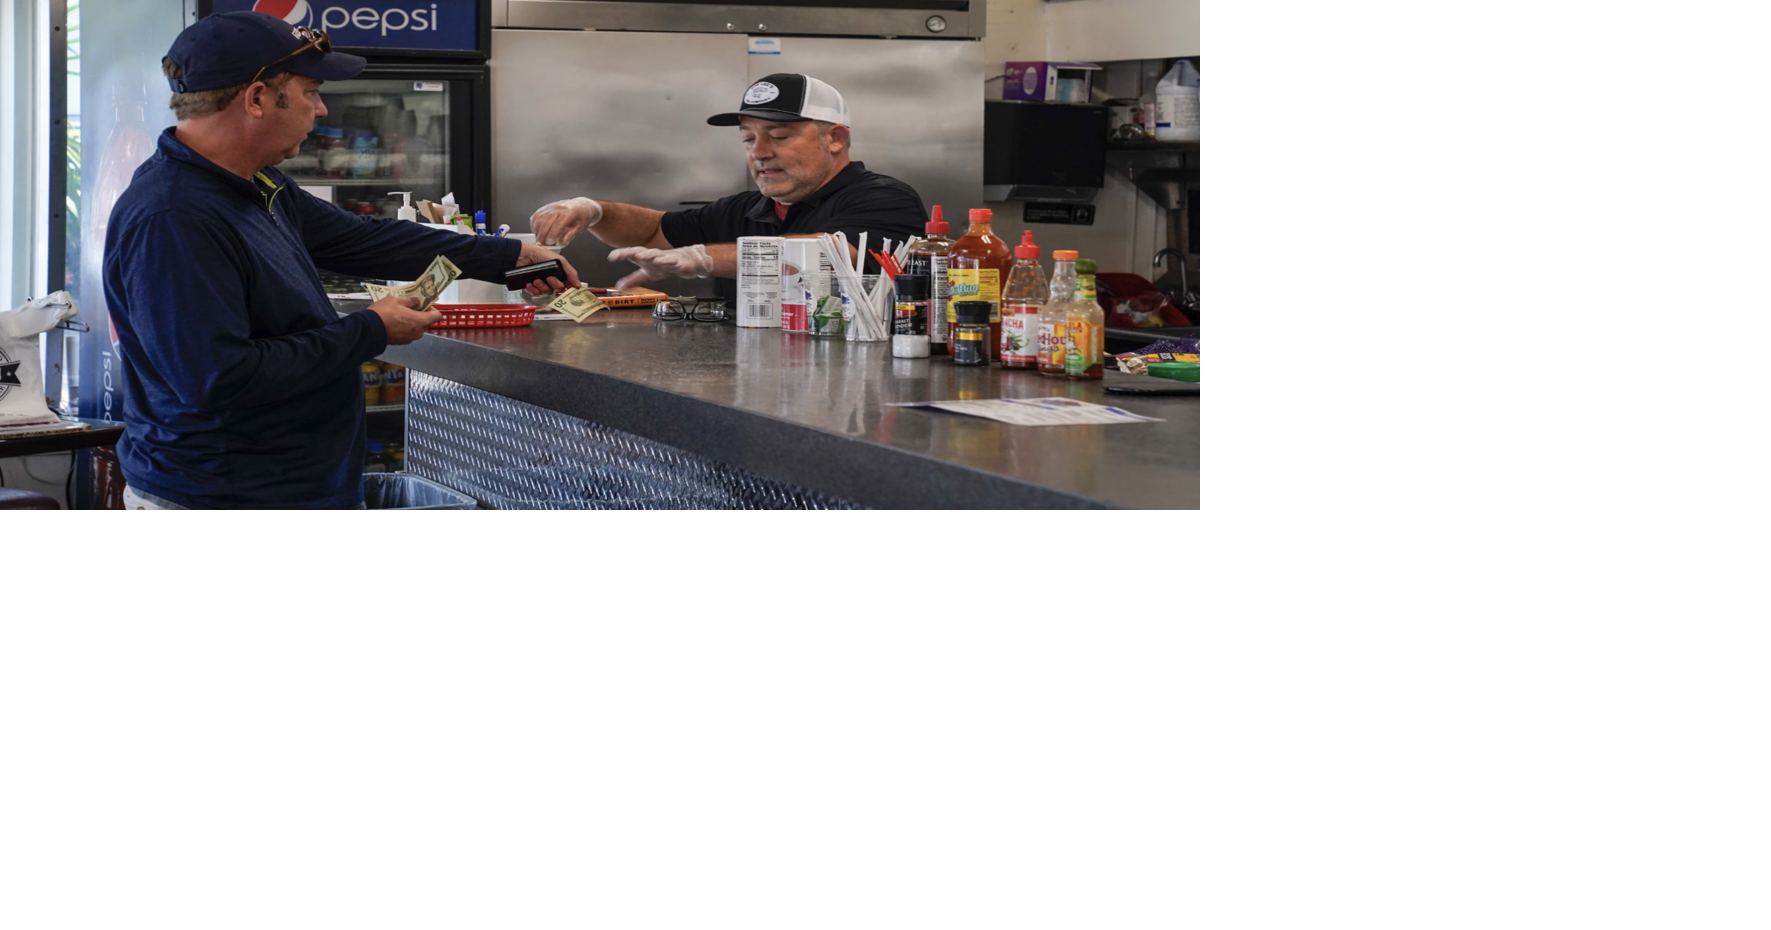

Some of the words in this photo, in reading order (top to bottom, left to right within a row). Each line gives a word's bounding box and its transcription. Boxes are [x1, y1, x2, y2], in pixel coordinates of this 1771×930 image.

[321, 3, 438, 37] pepsi
[554, 298, 567, 309] 20
[102, 351, 114, 423] pepsi
